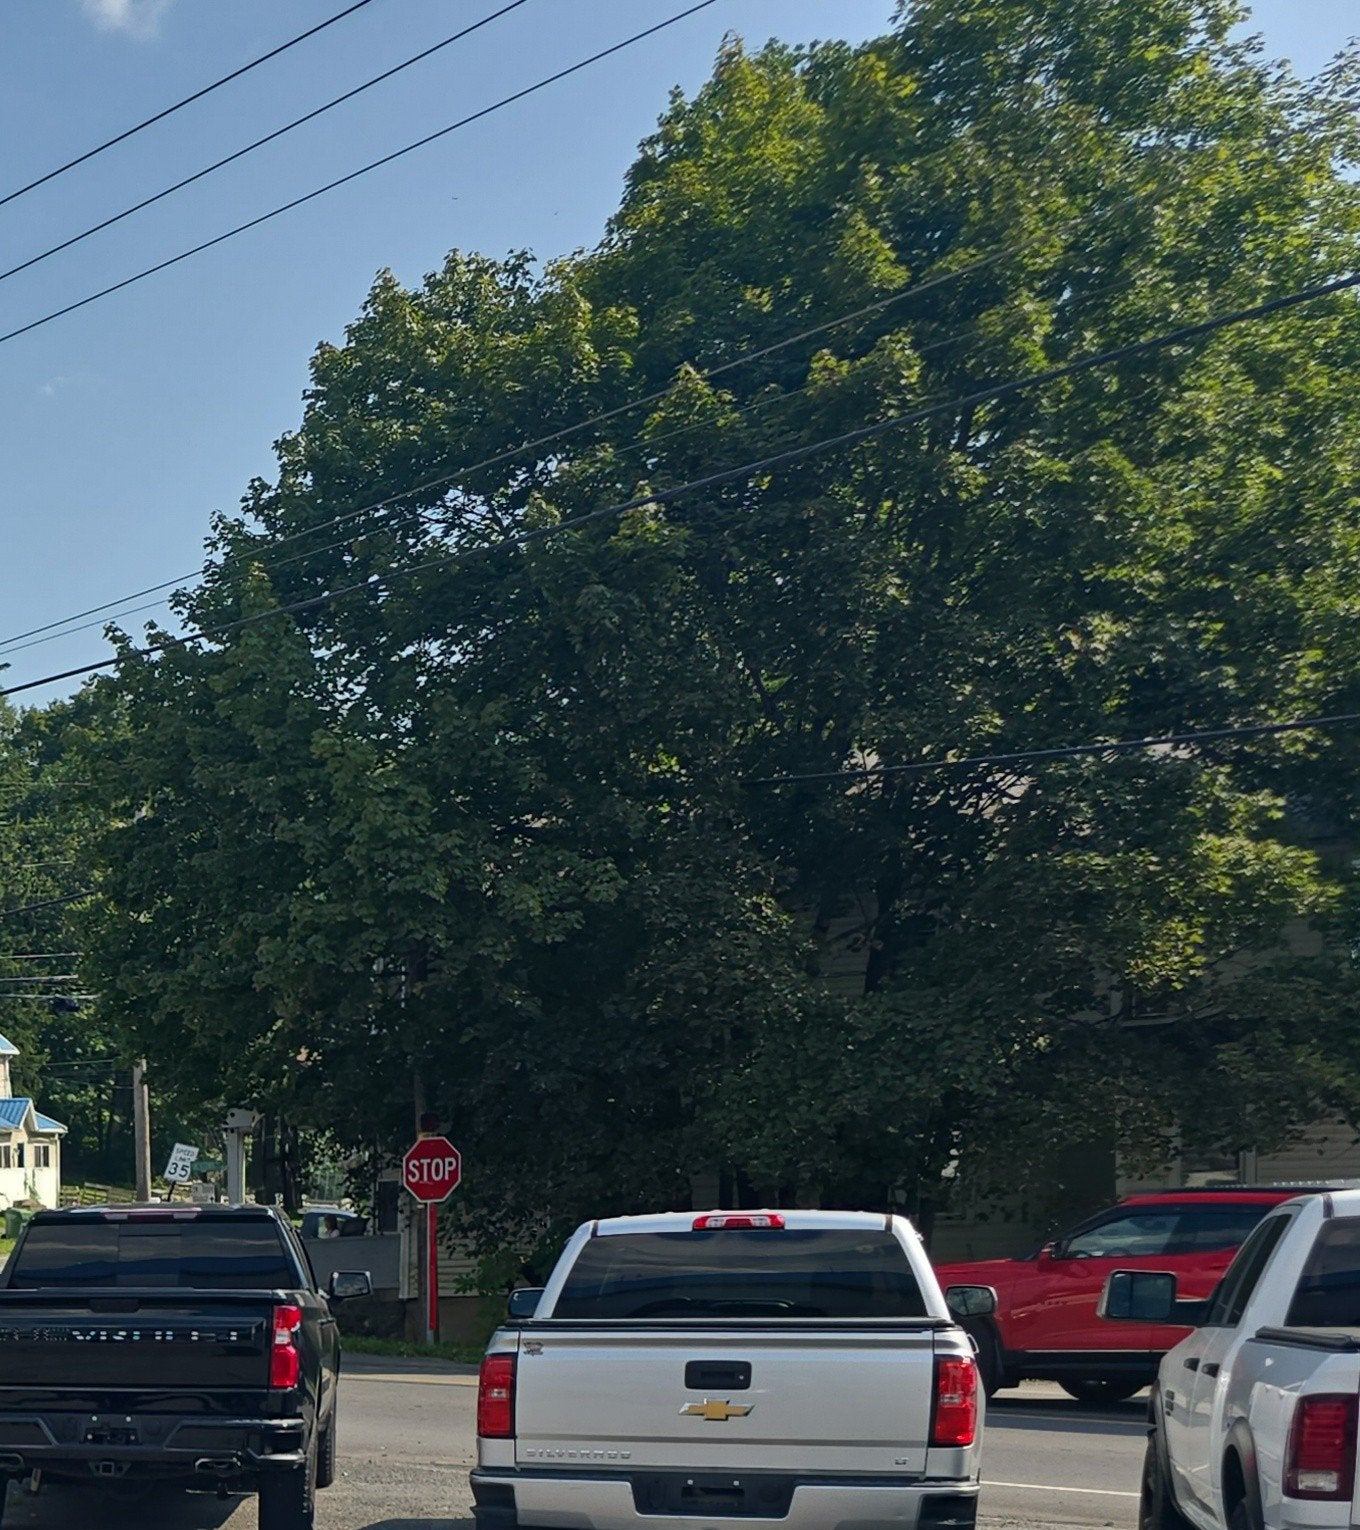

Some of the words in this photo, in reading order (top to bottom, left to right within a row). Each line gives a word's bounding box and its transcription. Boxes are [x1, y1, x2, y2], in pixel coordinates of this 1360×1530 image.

[168, 1162, 190, 1178] 35
[407, 1157, 457, 1183] STOP
[526, 1448, 632, 1460] SILVERADO
